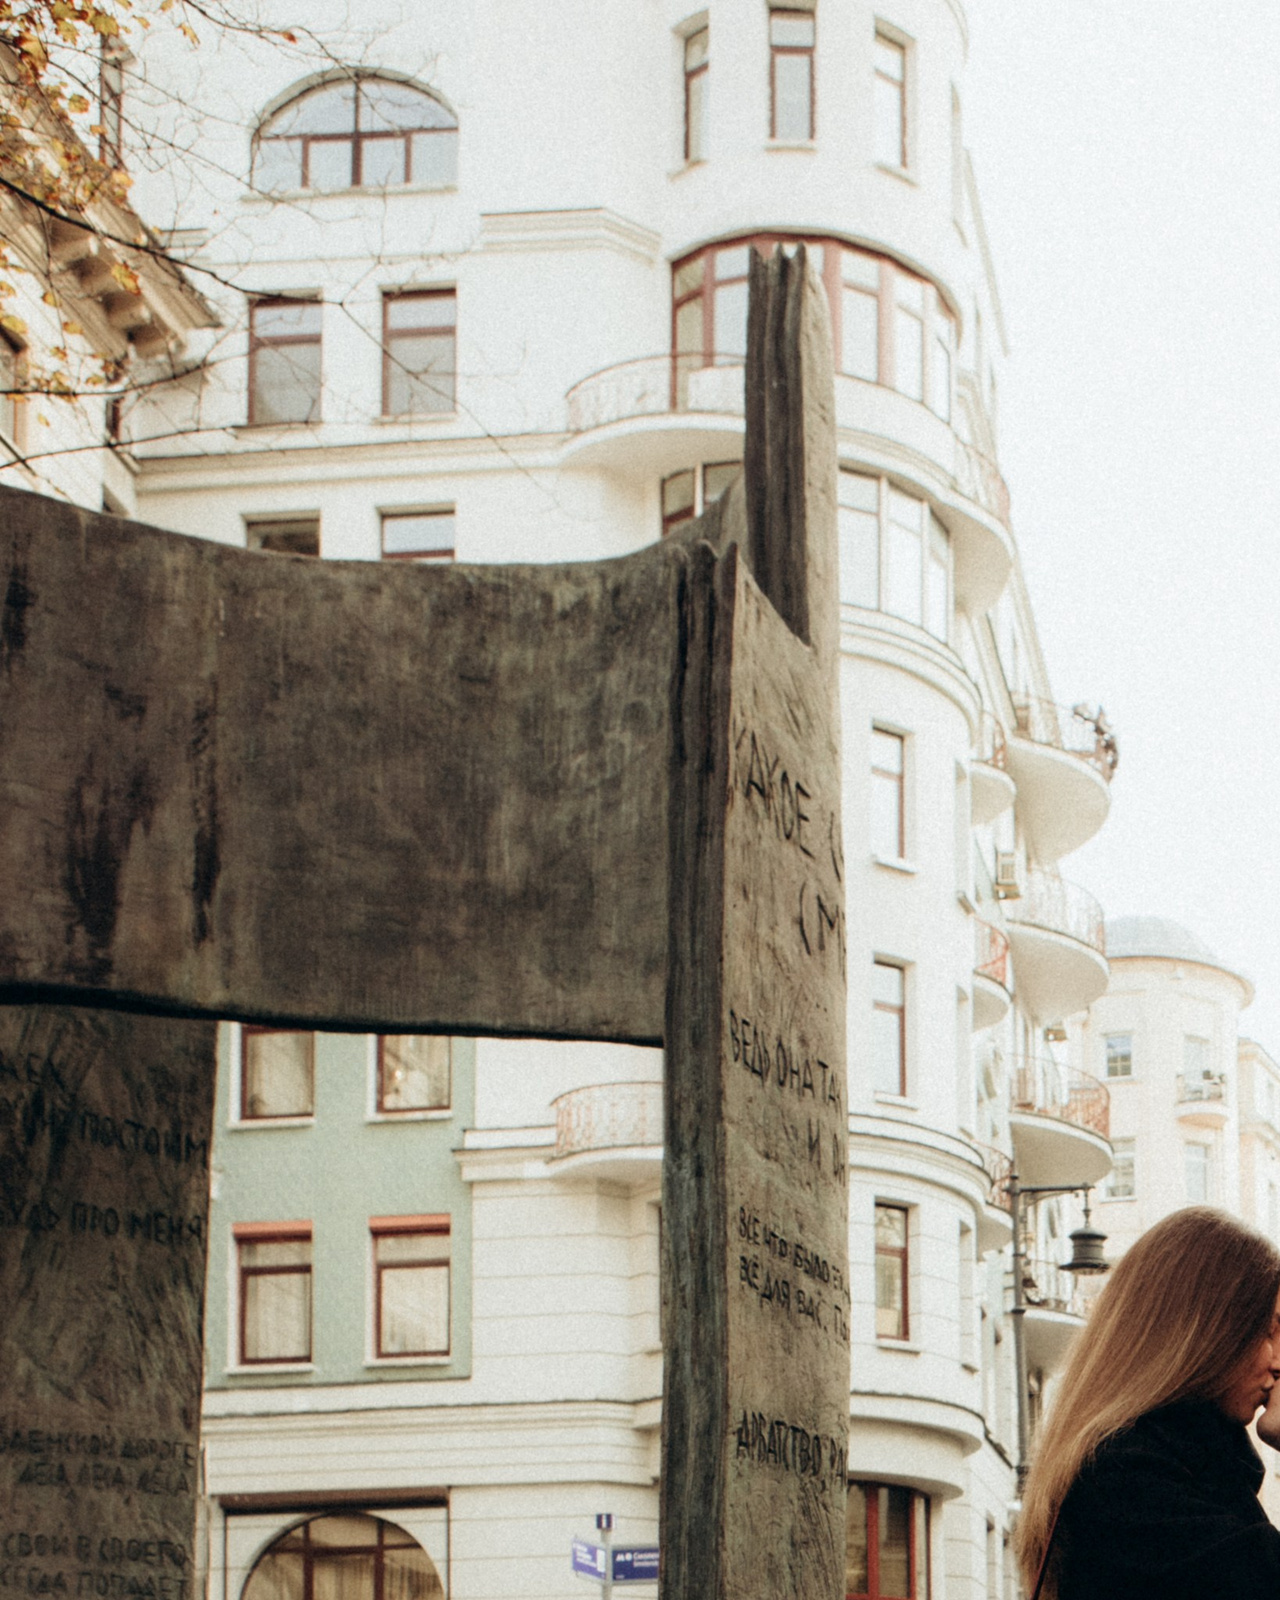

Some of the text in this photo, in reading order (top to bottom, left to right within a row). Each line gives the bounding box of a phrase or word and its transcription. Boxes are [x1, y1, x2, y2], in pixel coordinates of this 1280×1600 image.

[731, 719, 815, 859] КАКОЕ
[729, 1009, 771, 1087] ВЕДЬ
[776, 1035, 815, 1101] ОНА
[70, 1202, 121, 1236] ПРО
[763, 1223, 788, 1258] ЧТО
[793, 1243, 830, 1284] БЫЛО
[760, 1270, 791, 1319] ДЛЯ
